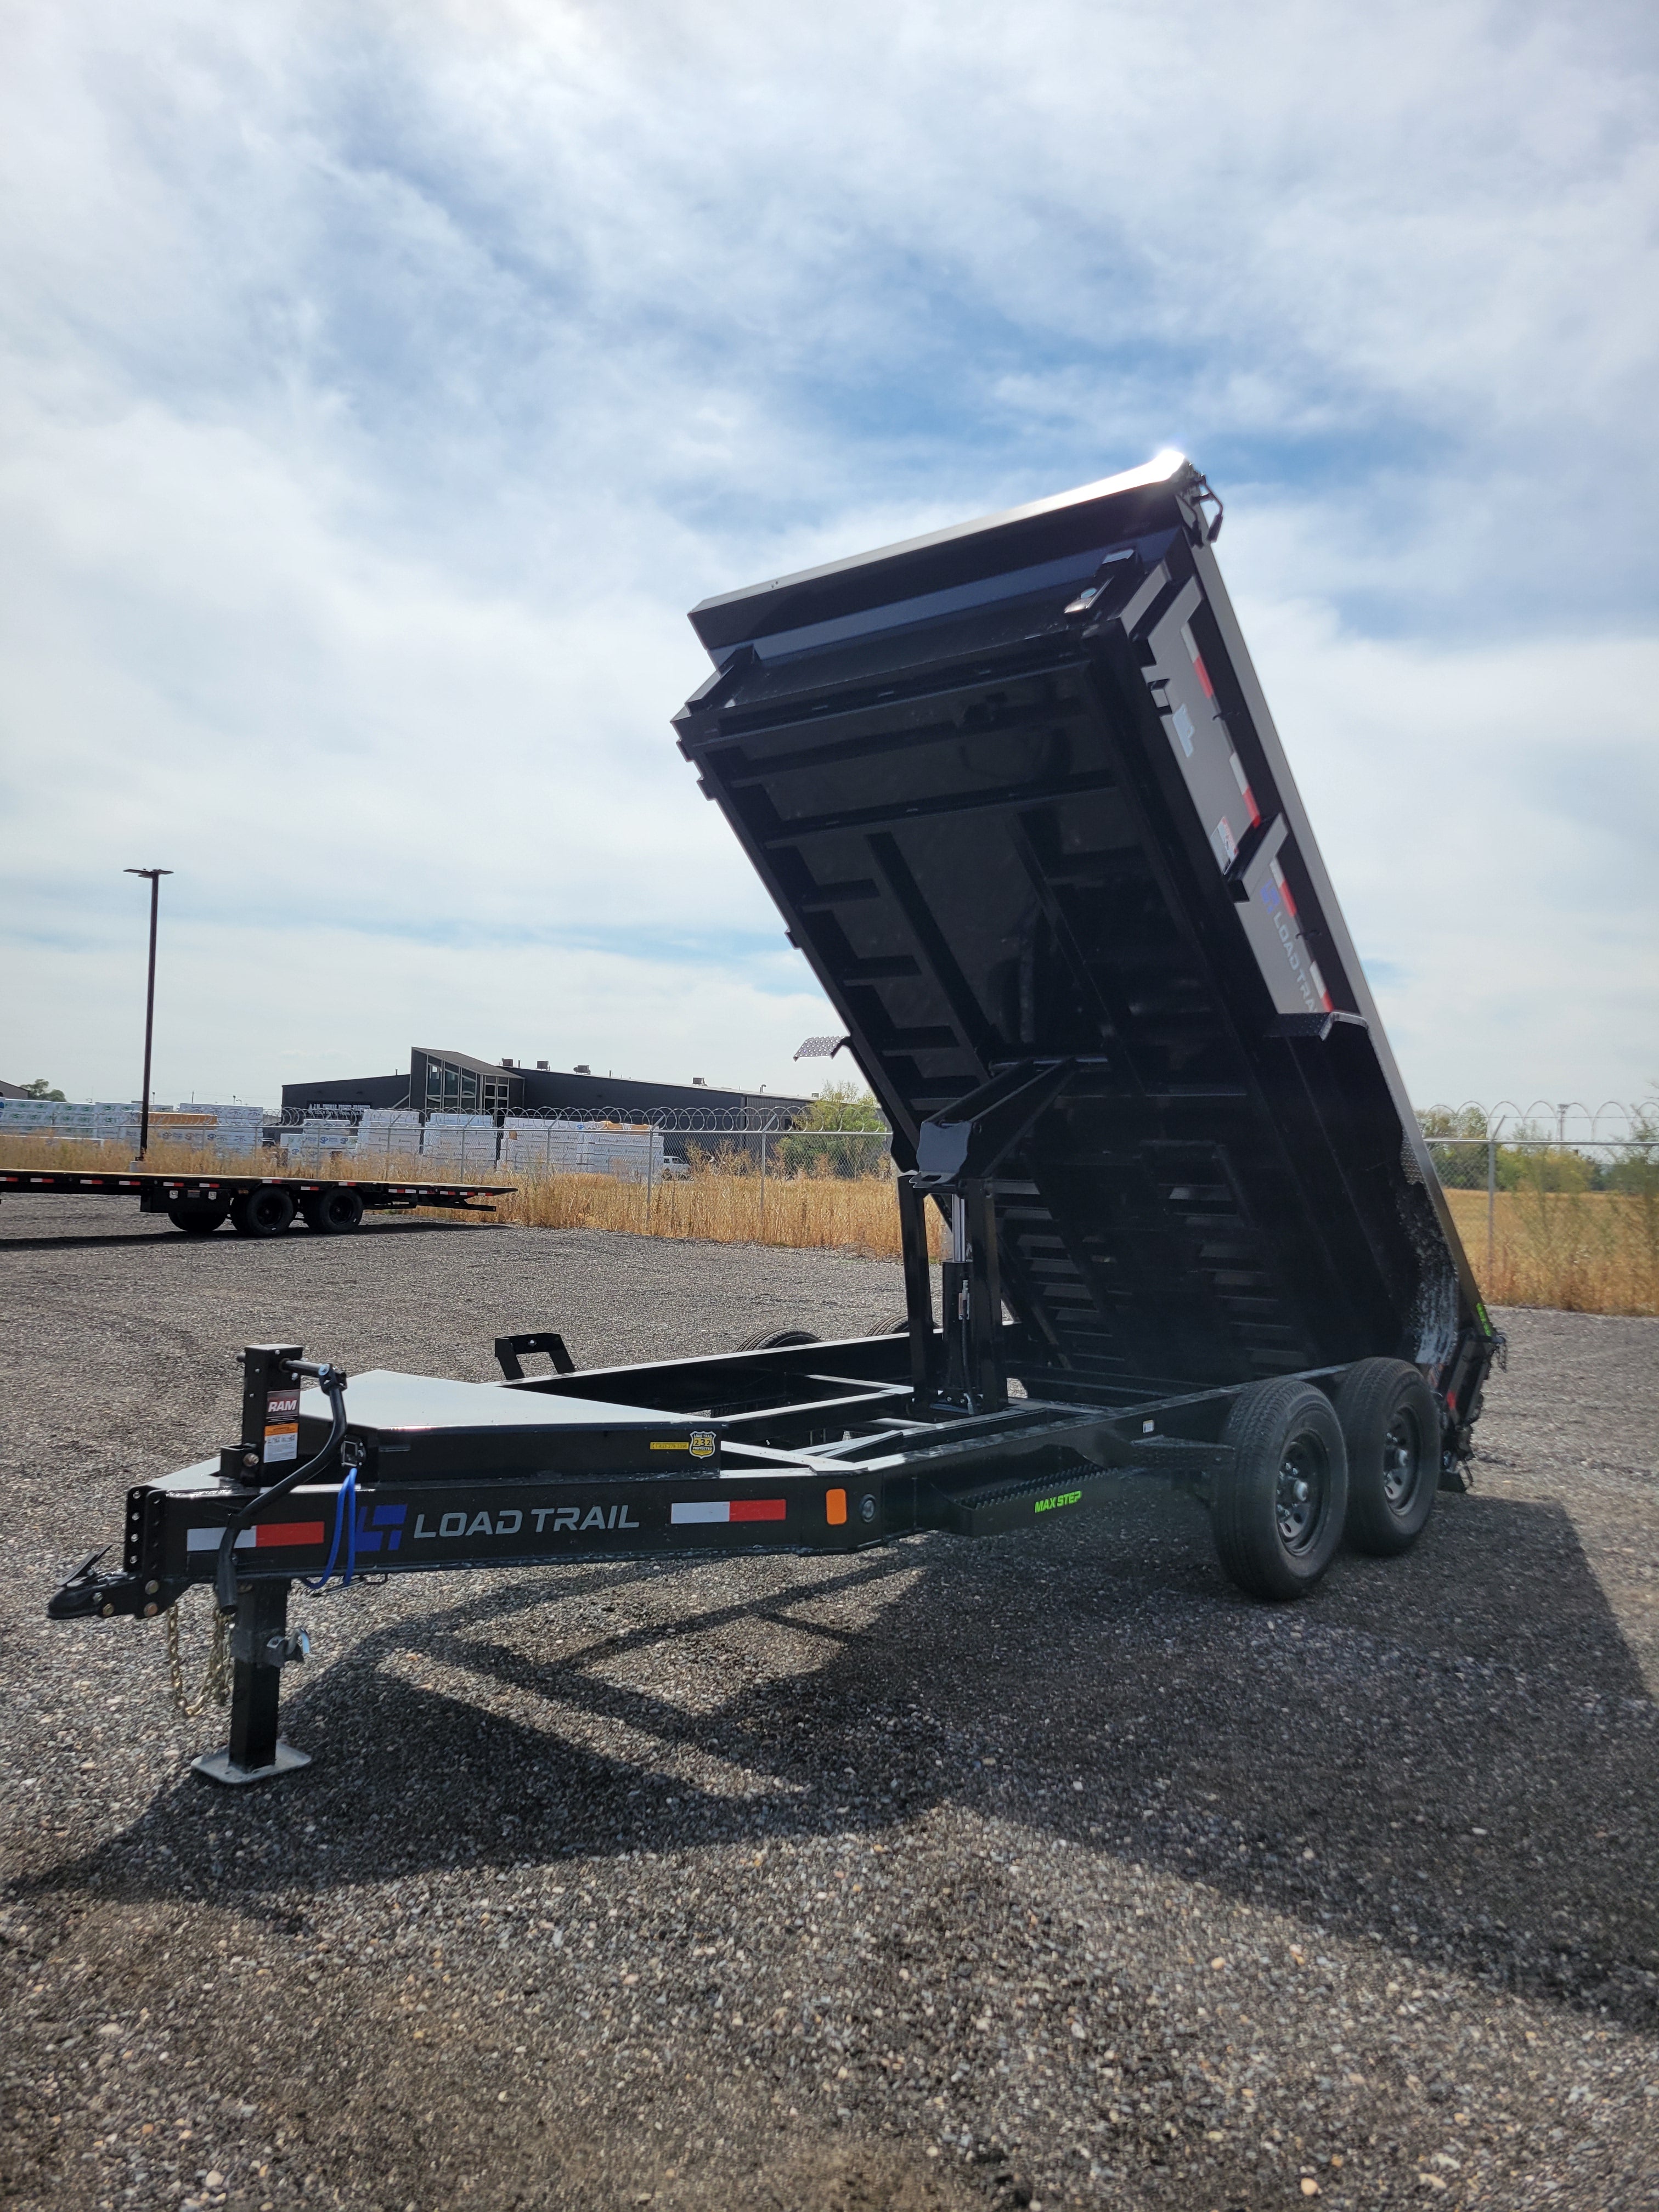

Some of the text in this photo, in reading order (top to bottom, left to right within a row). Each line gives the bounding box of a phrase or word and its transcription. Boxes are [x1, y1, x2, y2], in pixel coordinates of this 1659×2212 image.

[1273, 911, 1300, 970] LOAD
[268, 1400, 297, 1413] RAM
[695, 1438, 711, 1447] 232
[1035, 1490, 1082, 1513] MAX STEP
[414, 1505, 640, 1538] LOAD TRAIL
